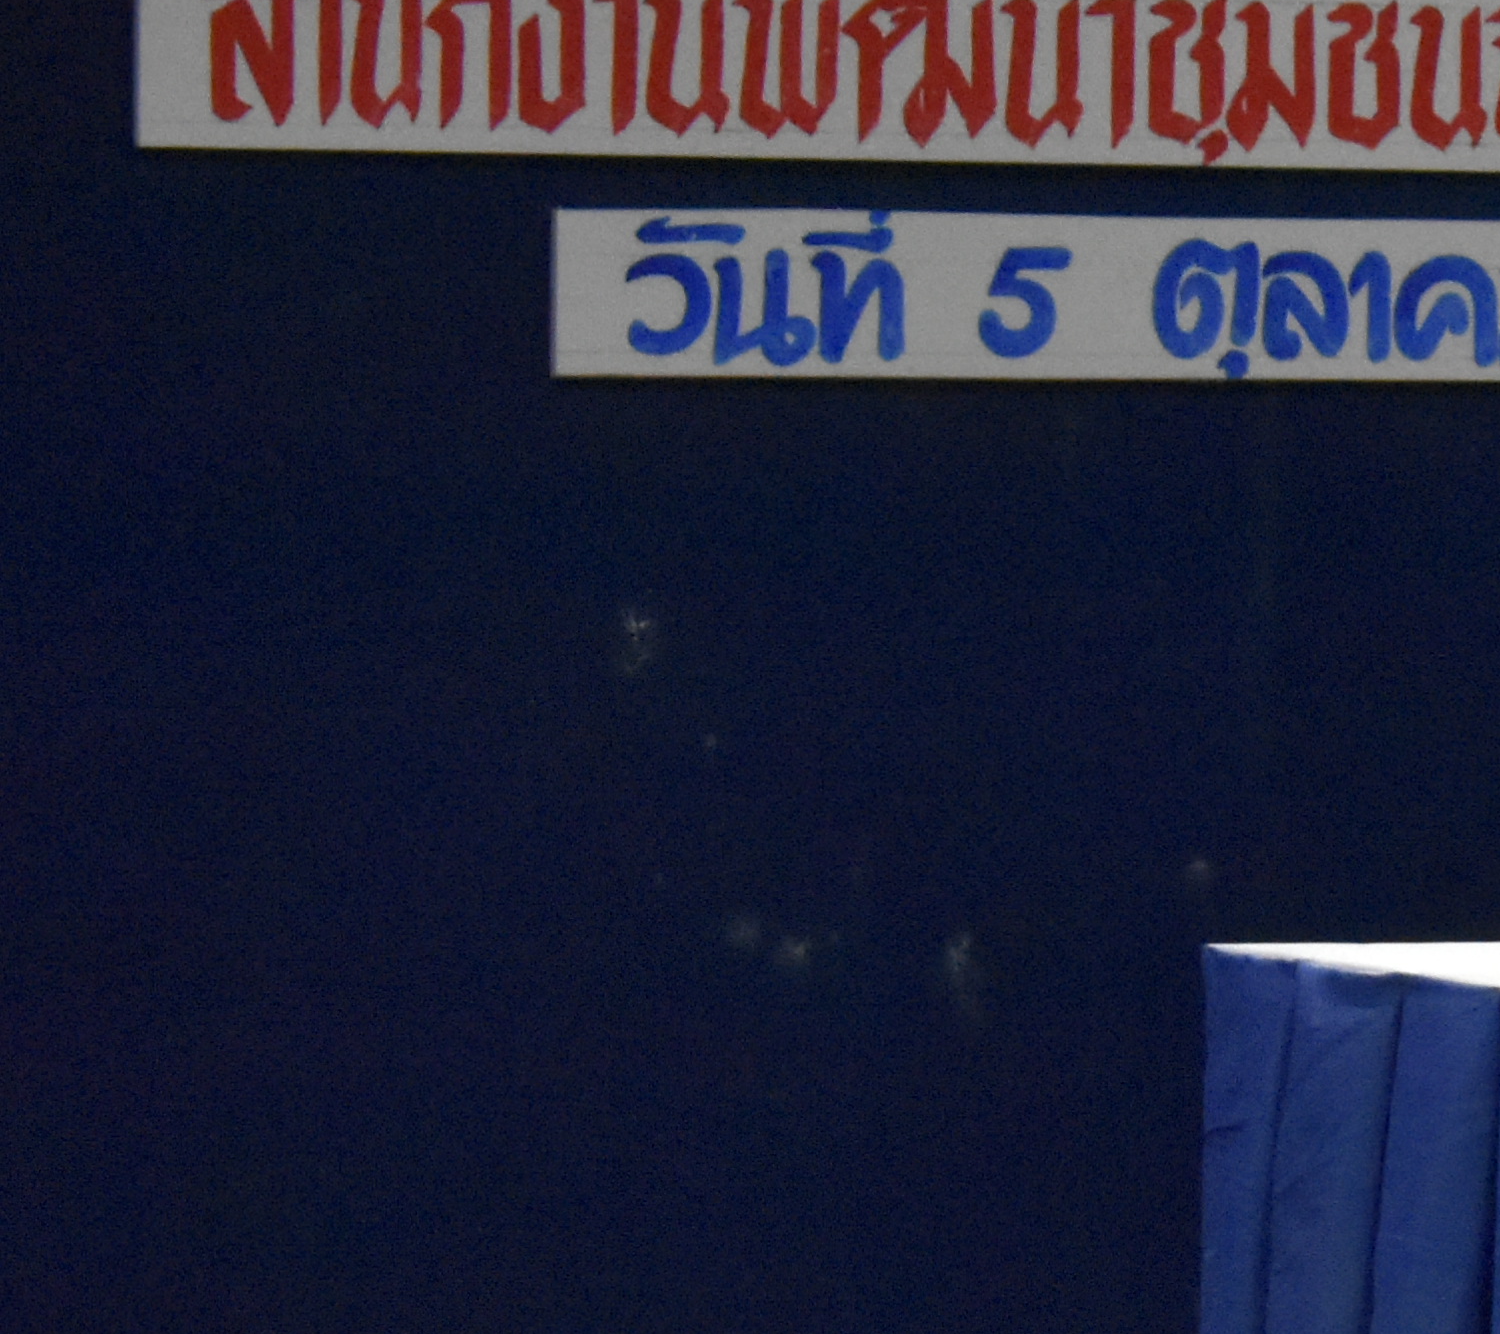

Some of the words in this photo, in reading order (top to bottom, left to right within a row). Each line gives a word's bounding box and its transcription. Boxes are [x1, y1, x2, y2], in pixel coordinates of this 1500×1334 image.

[625, 210, 905, 366] วันที่
[977, 245, 1072, 359] 5
